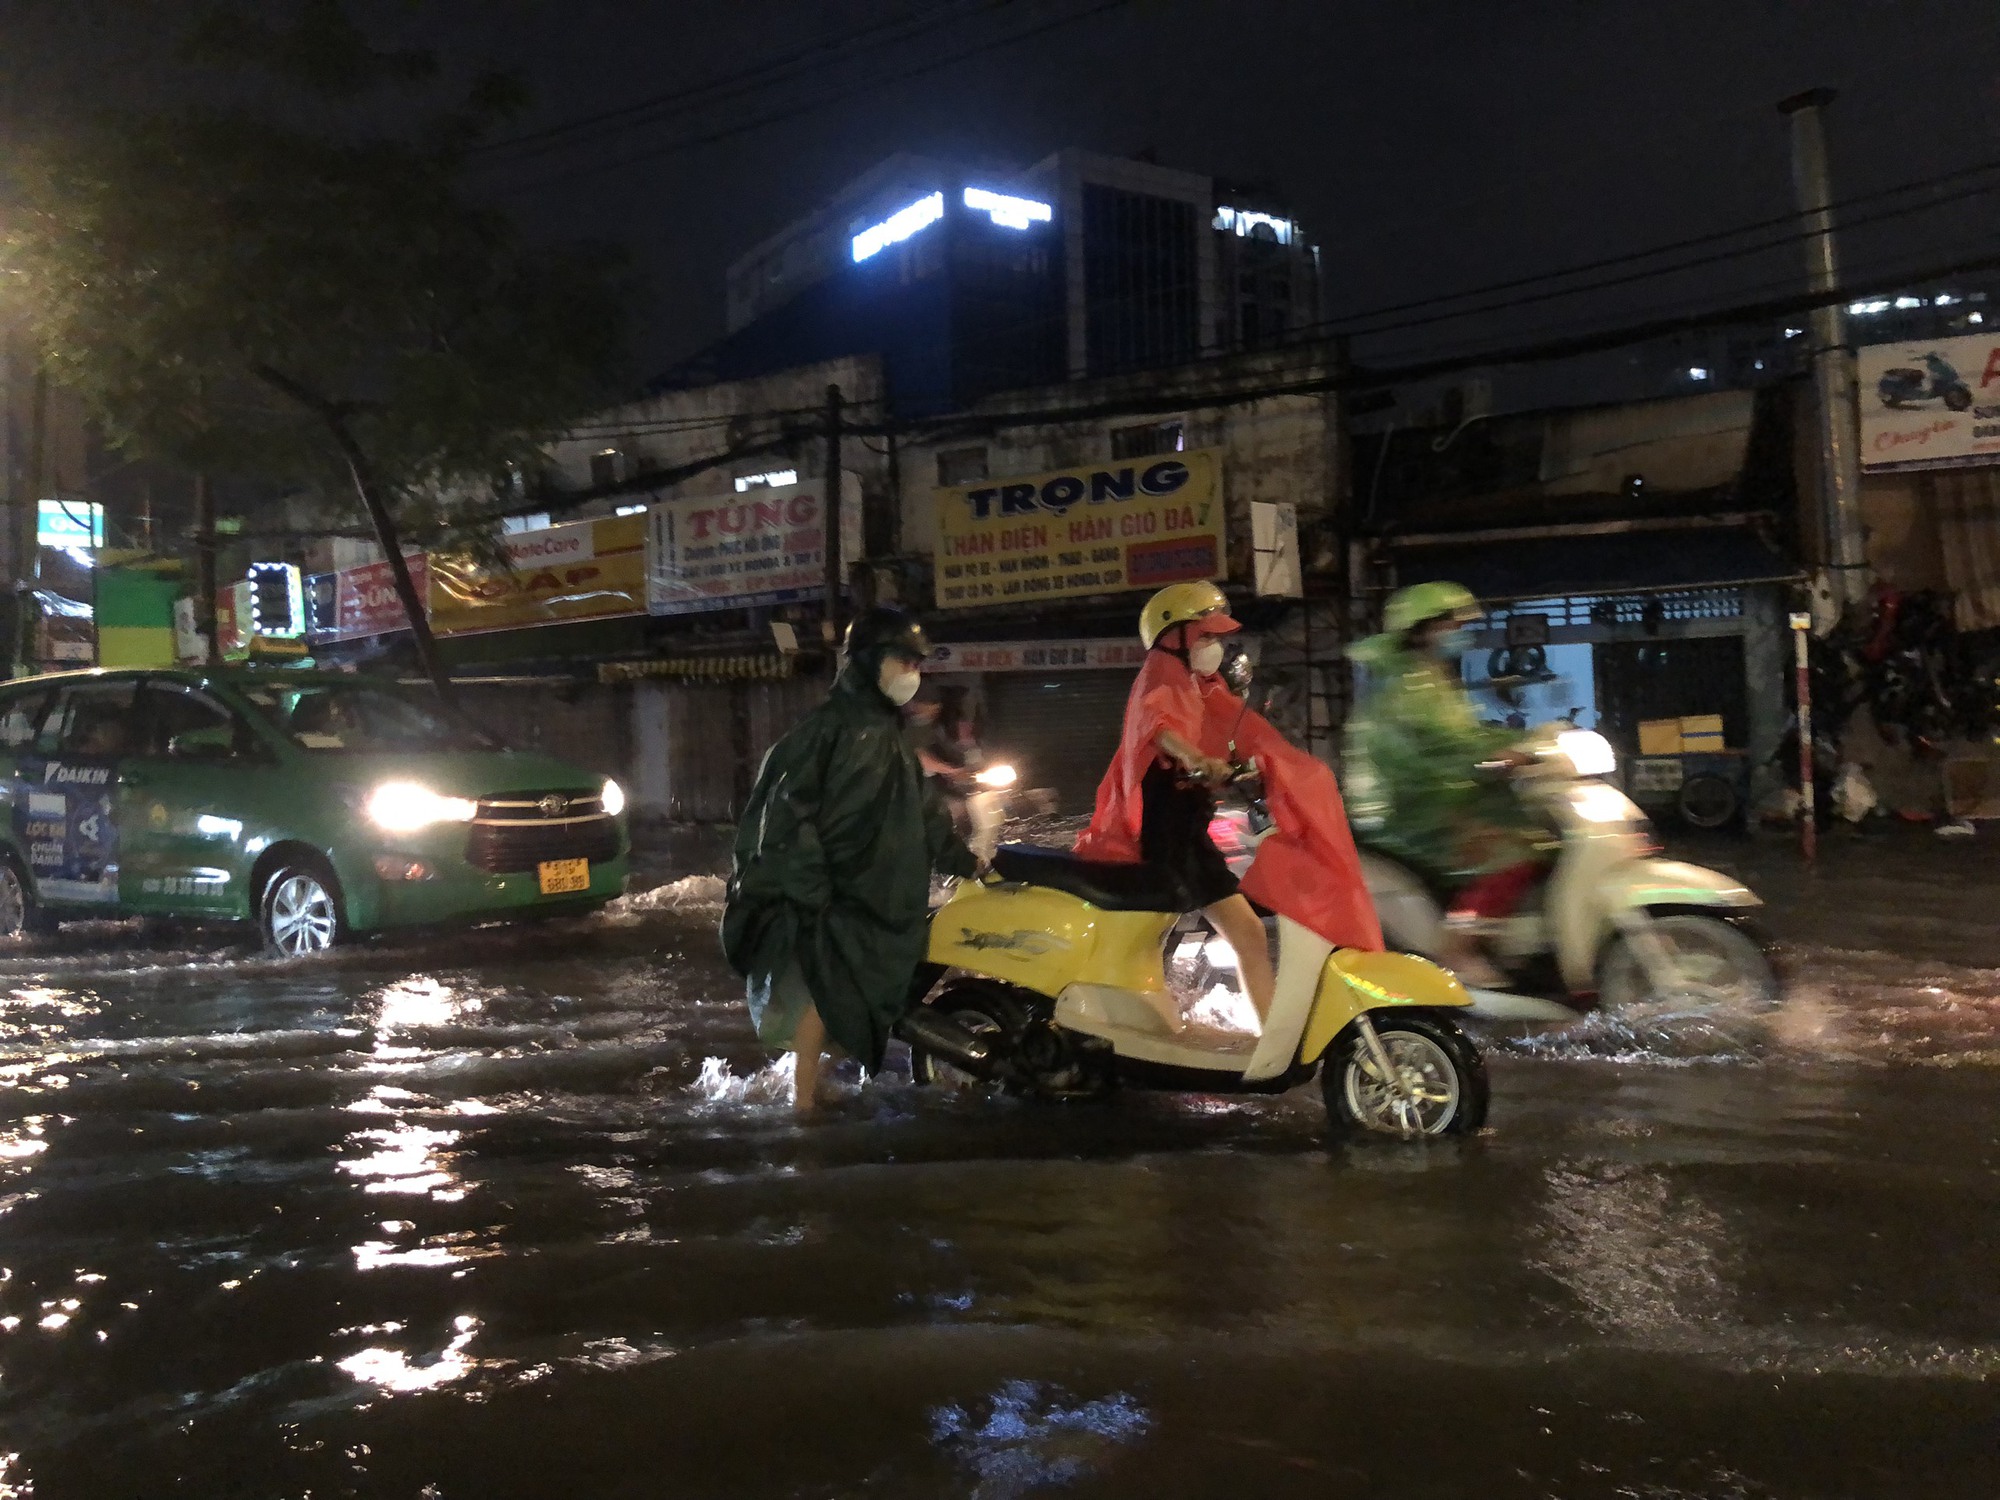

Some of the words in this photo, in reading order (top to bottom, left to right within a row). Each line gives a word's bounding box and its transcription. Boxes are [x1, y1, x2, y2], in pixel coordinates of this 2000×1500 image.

[966, 460, 1190, 518] TRỌNG
[1069, 514, 1112, 543] HÀN
[57, 767, 110, 785] DAIKIN
